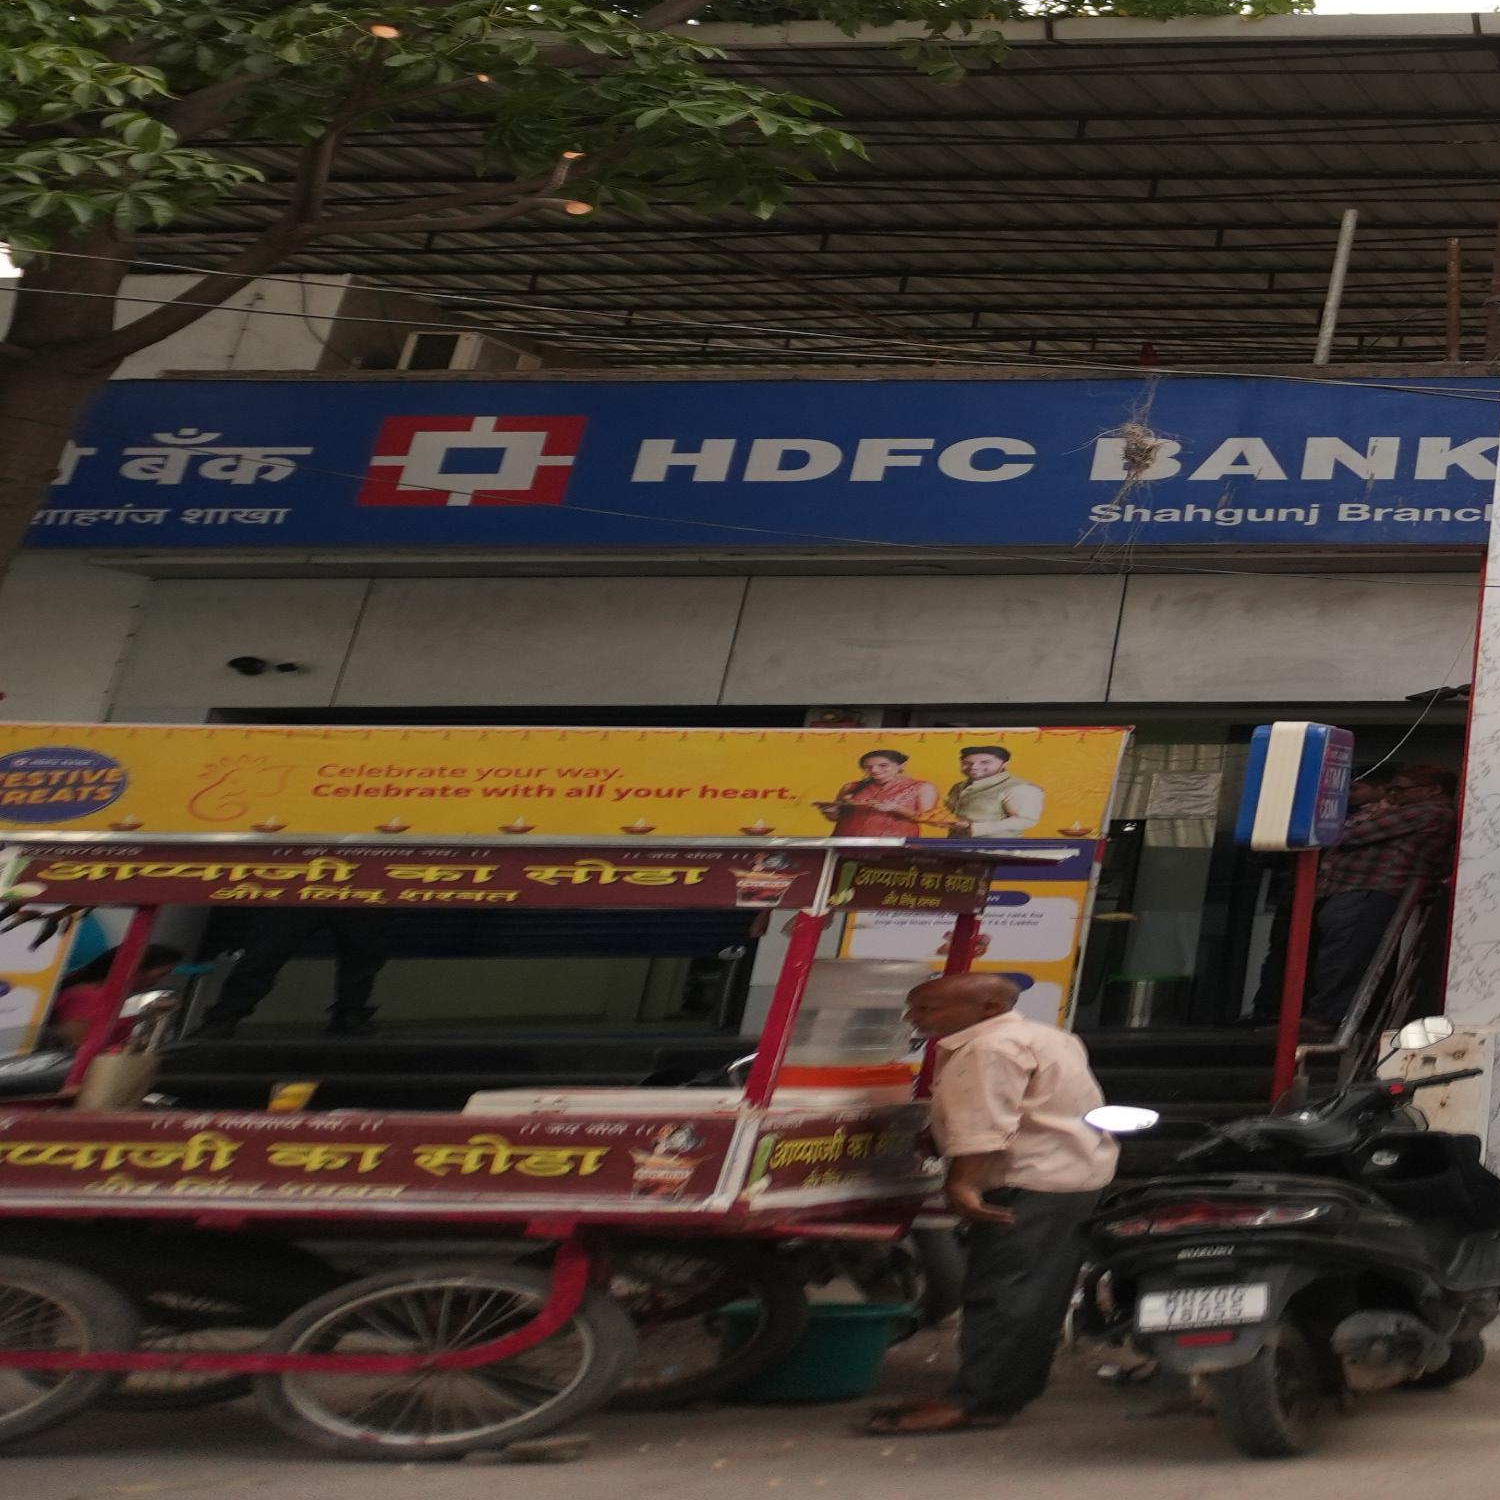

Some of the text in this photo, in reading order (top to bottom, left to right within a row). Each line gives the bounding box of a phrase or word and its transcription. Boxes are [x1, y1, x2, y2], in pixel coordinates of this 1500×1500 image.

[630, 436, 1499, 482] HDFC BANK
[179, 507, 293, 526] शाखा
[1088, 502, 1320, 526] Shahgunj
[0, 767, 127, 788] ESTIVE
[316, 763, 625, 781] Celebrate your way.
[0, 784, 114, 805] REATS
[311, 783, 797, 801] Celebrate with all your heart.
[385, 862, 501, 884] का
[523, 858, 712, 886] सोडा
[266, 1142, 393, 1174] का
[412, 1132, 613, 1177] सोडा
